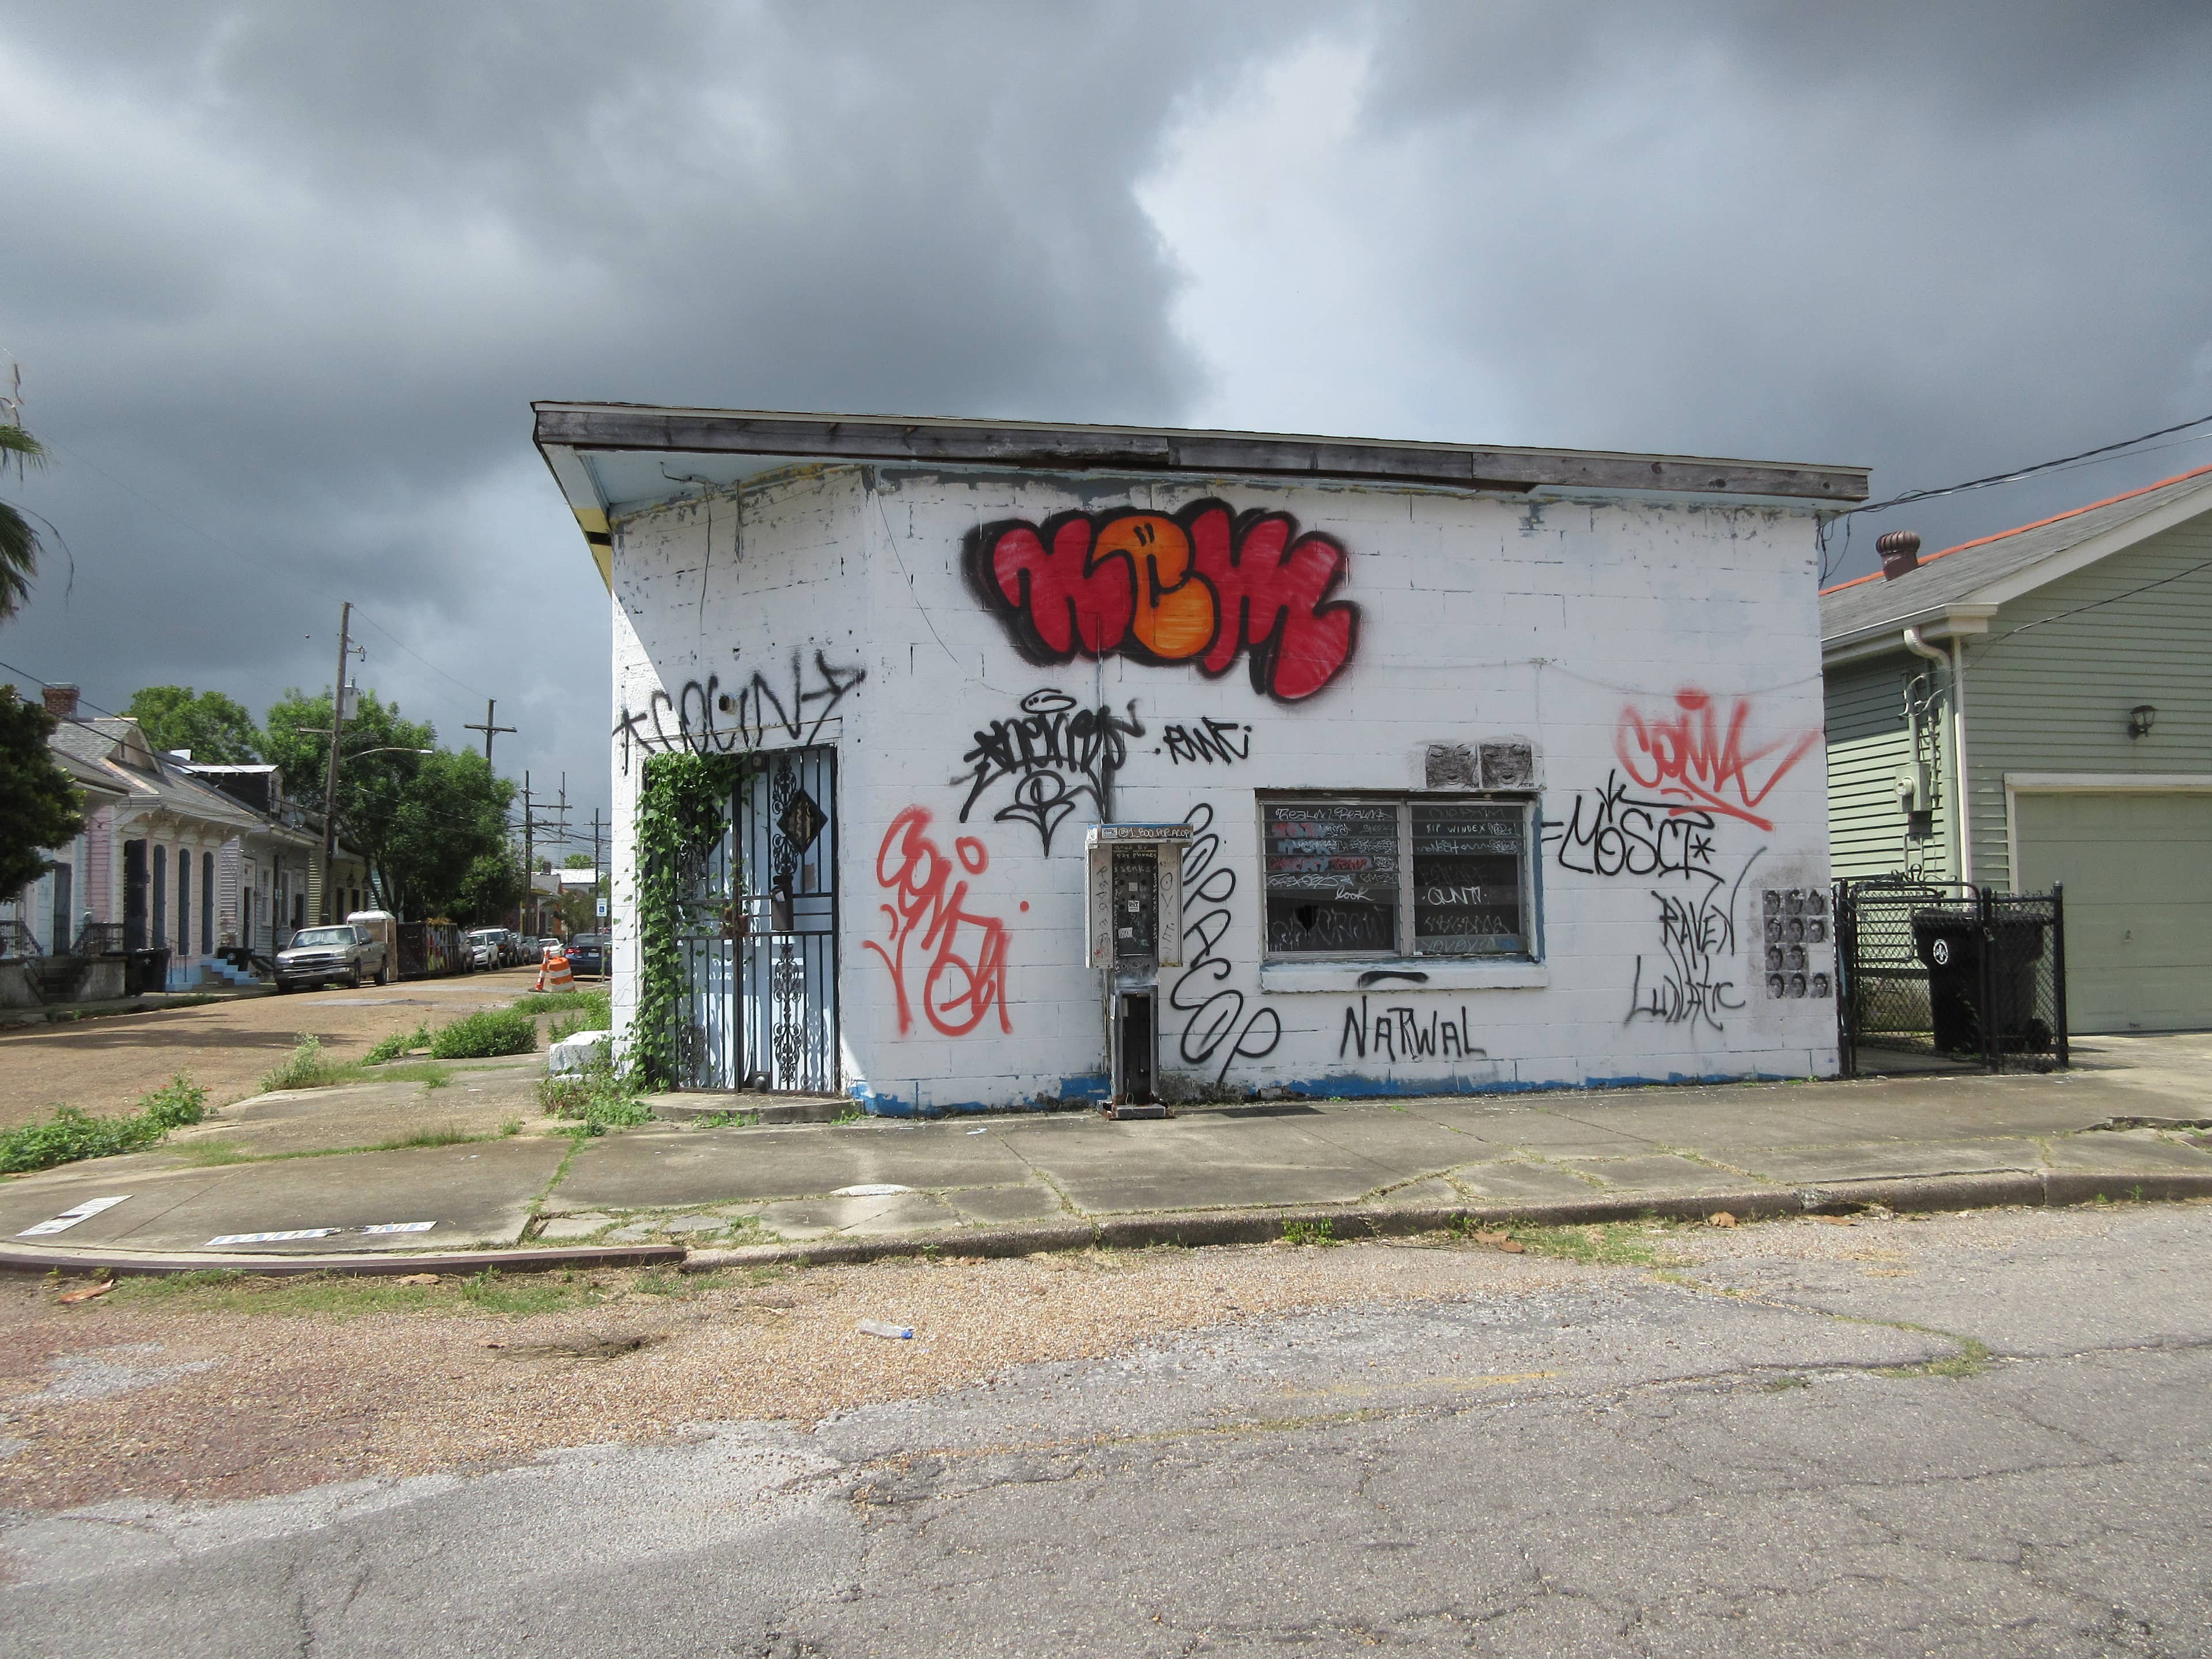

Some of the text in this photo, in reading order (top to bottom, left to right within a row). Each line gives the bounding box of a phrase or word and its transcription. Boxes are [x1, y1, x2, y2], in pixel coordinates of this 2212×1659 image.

[1426, 823, 1441, 834] RIP
[1447, 824, 1486, 834] WINDEX
[1335, 885, 1374, 901] look
